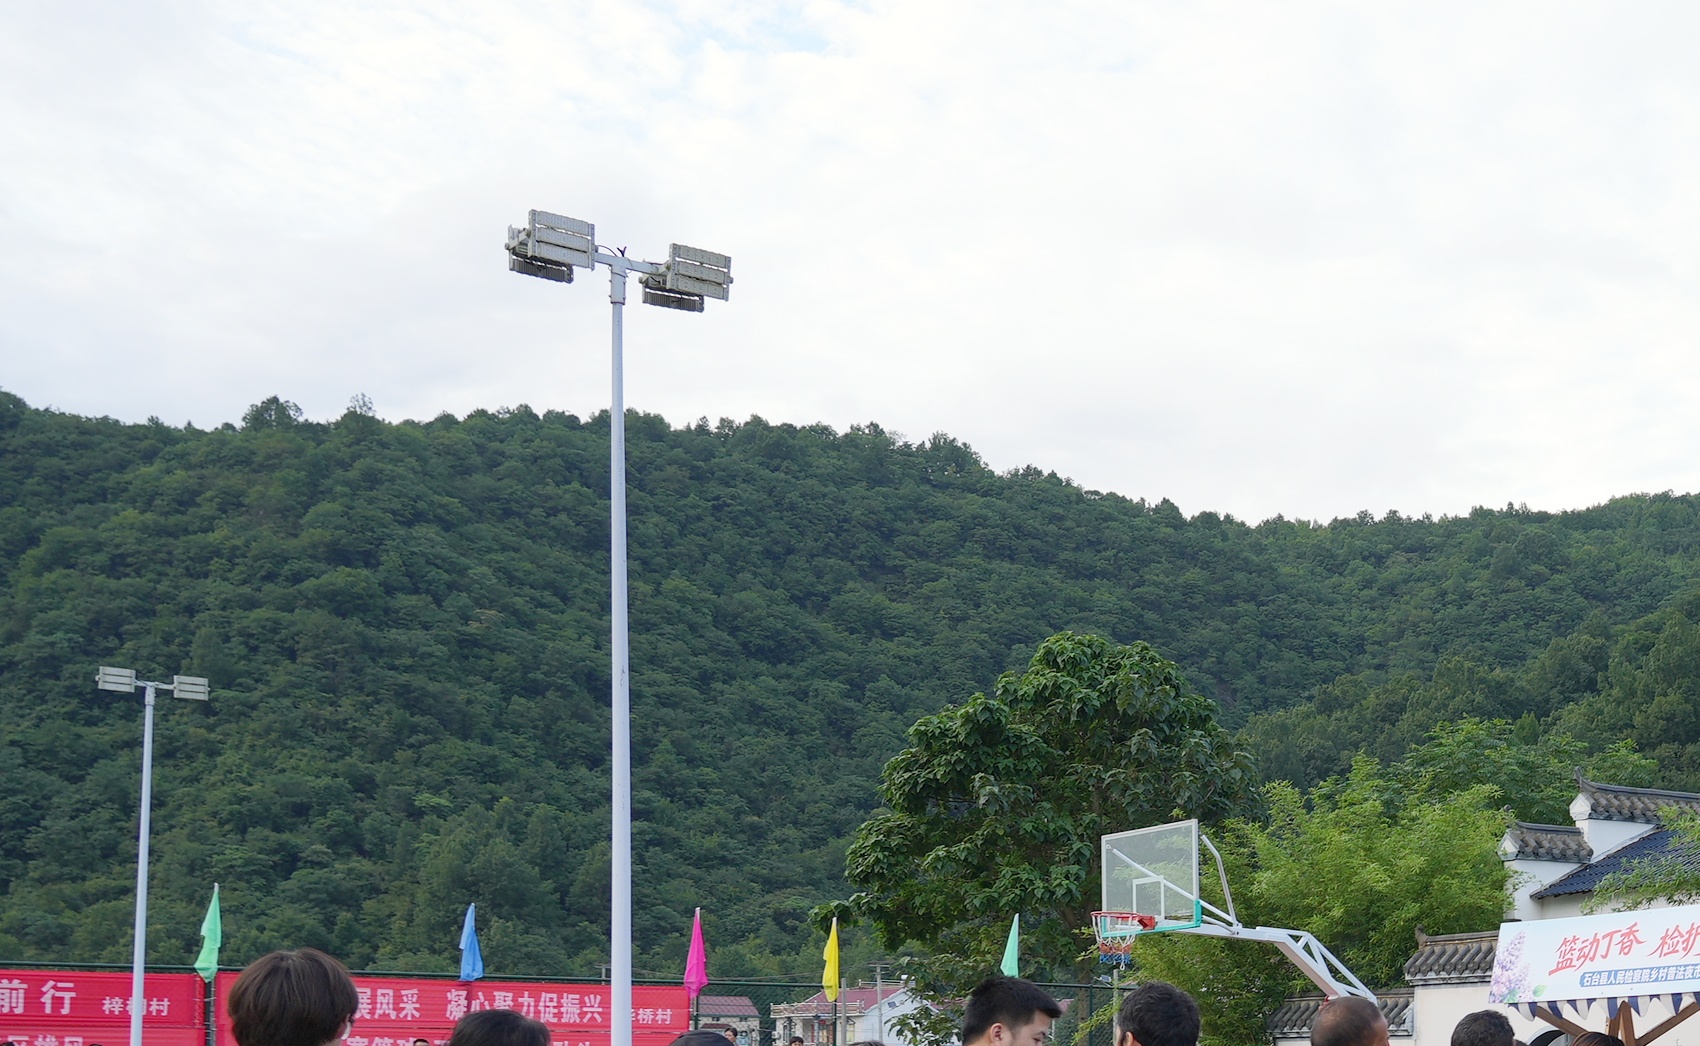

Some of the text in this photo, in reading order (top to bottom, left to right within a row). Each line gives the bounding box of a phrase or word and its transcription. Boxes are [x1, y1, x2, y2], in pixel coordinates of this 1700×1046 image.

[1549, 922, 1647, 976] 篮动丁香
[631, 1008, 673, 1024] 桥村
